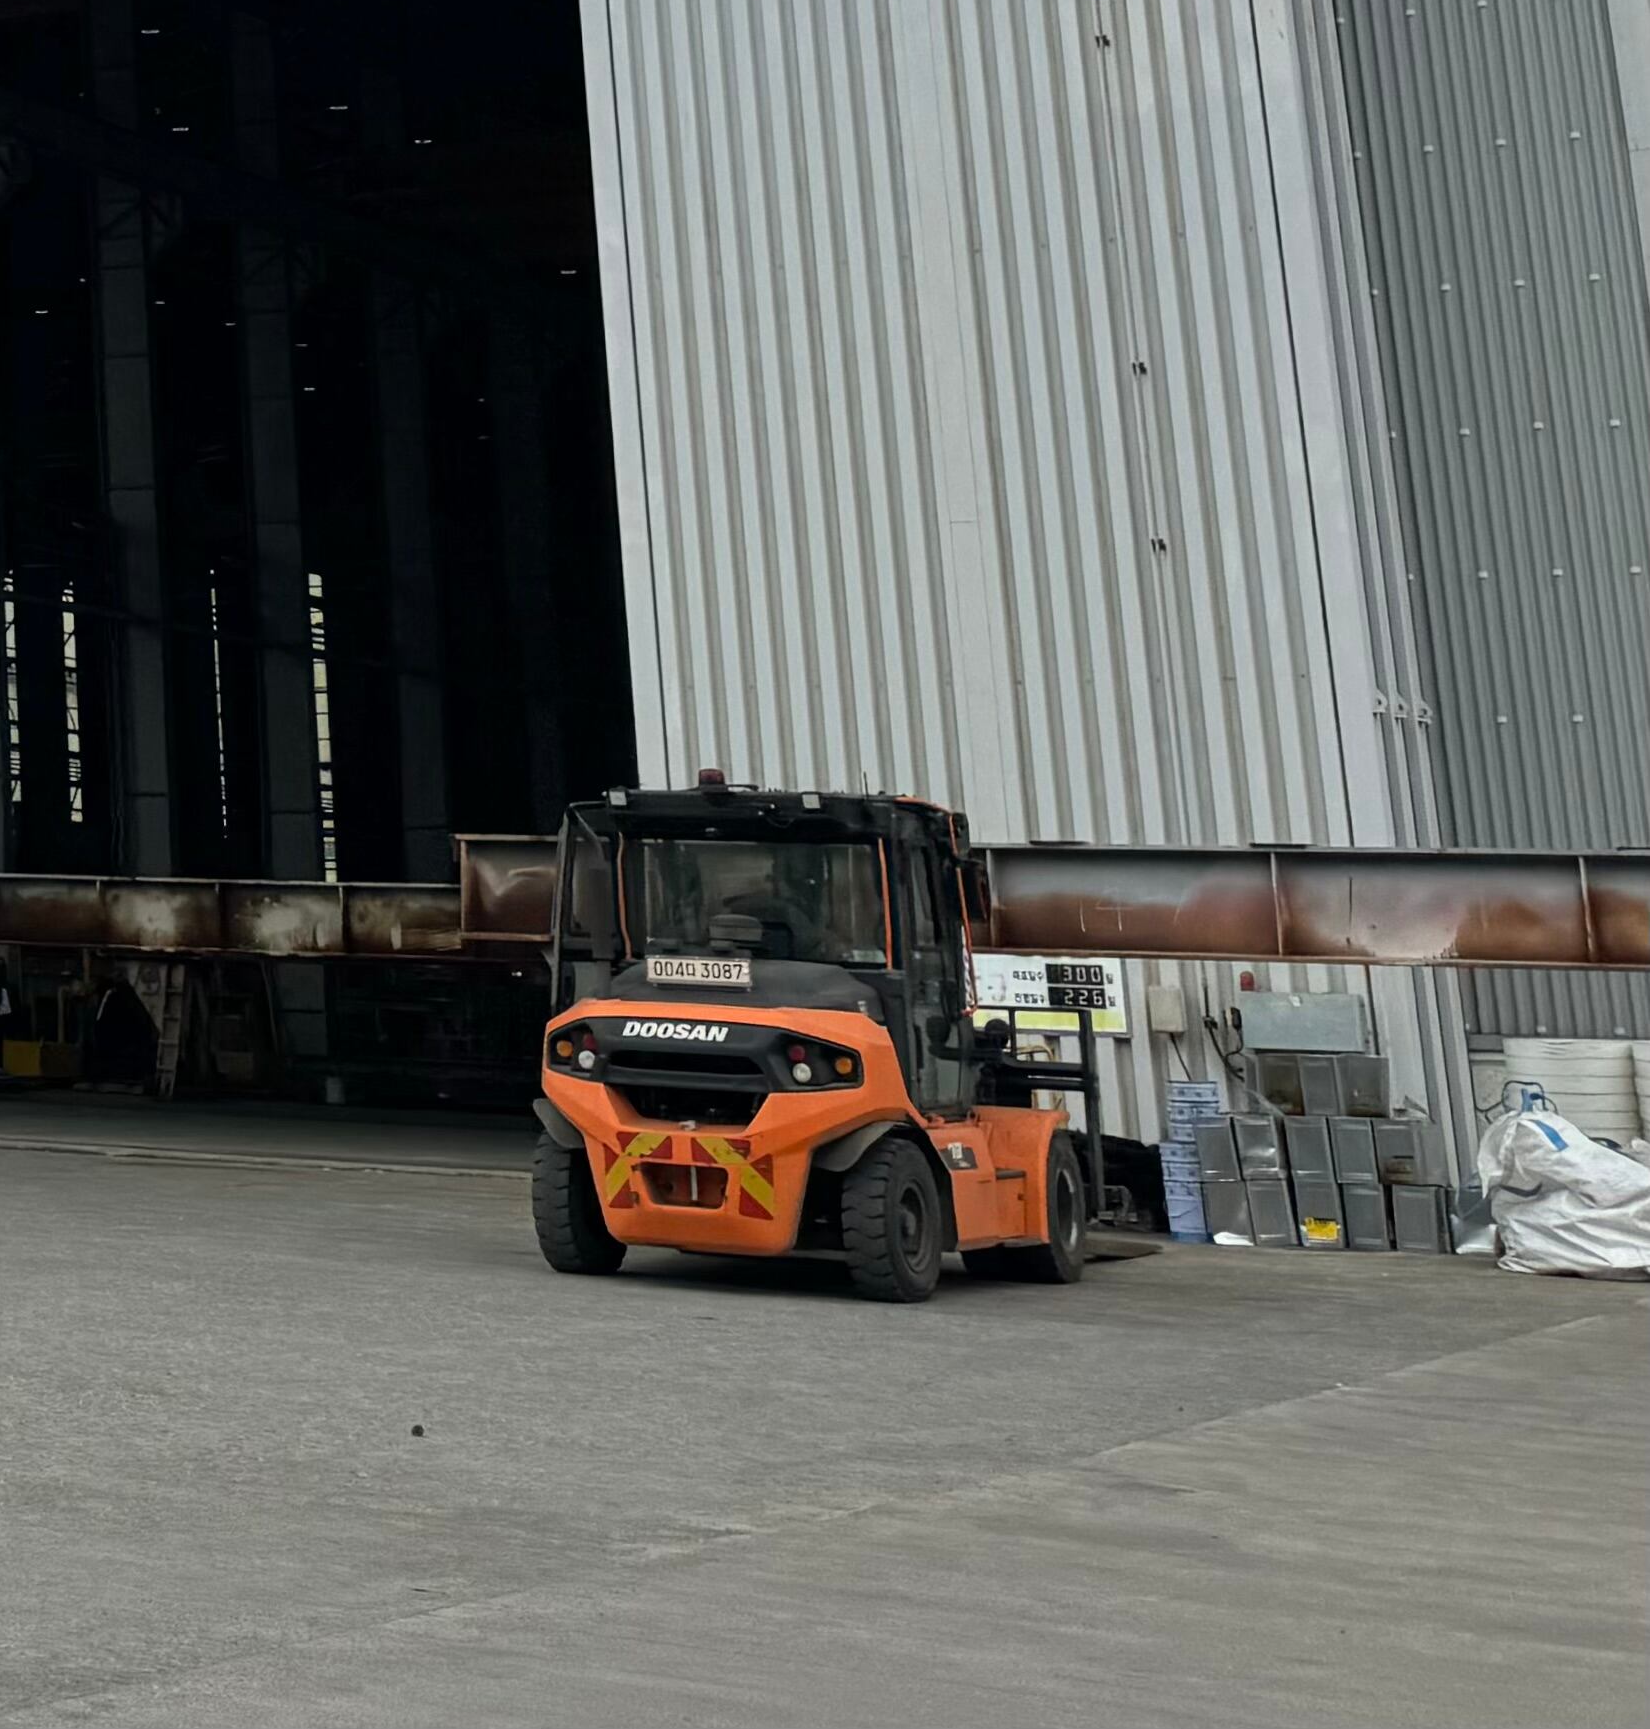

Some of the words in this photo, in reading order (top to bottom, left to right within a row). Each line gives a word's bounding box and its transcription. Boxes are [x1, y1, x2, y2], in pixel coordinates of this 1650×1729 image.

[700, 962, 743, 980] 3087
[1062, 965, 1102, 983] 300
[1064, 988, 1103, 1006] 226
[622, 1021, 729, 1042] DOOSAN
